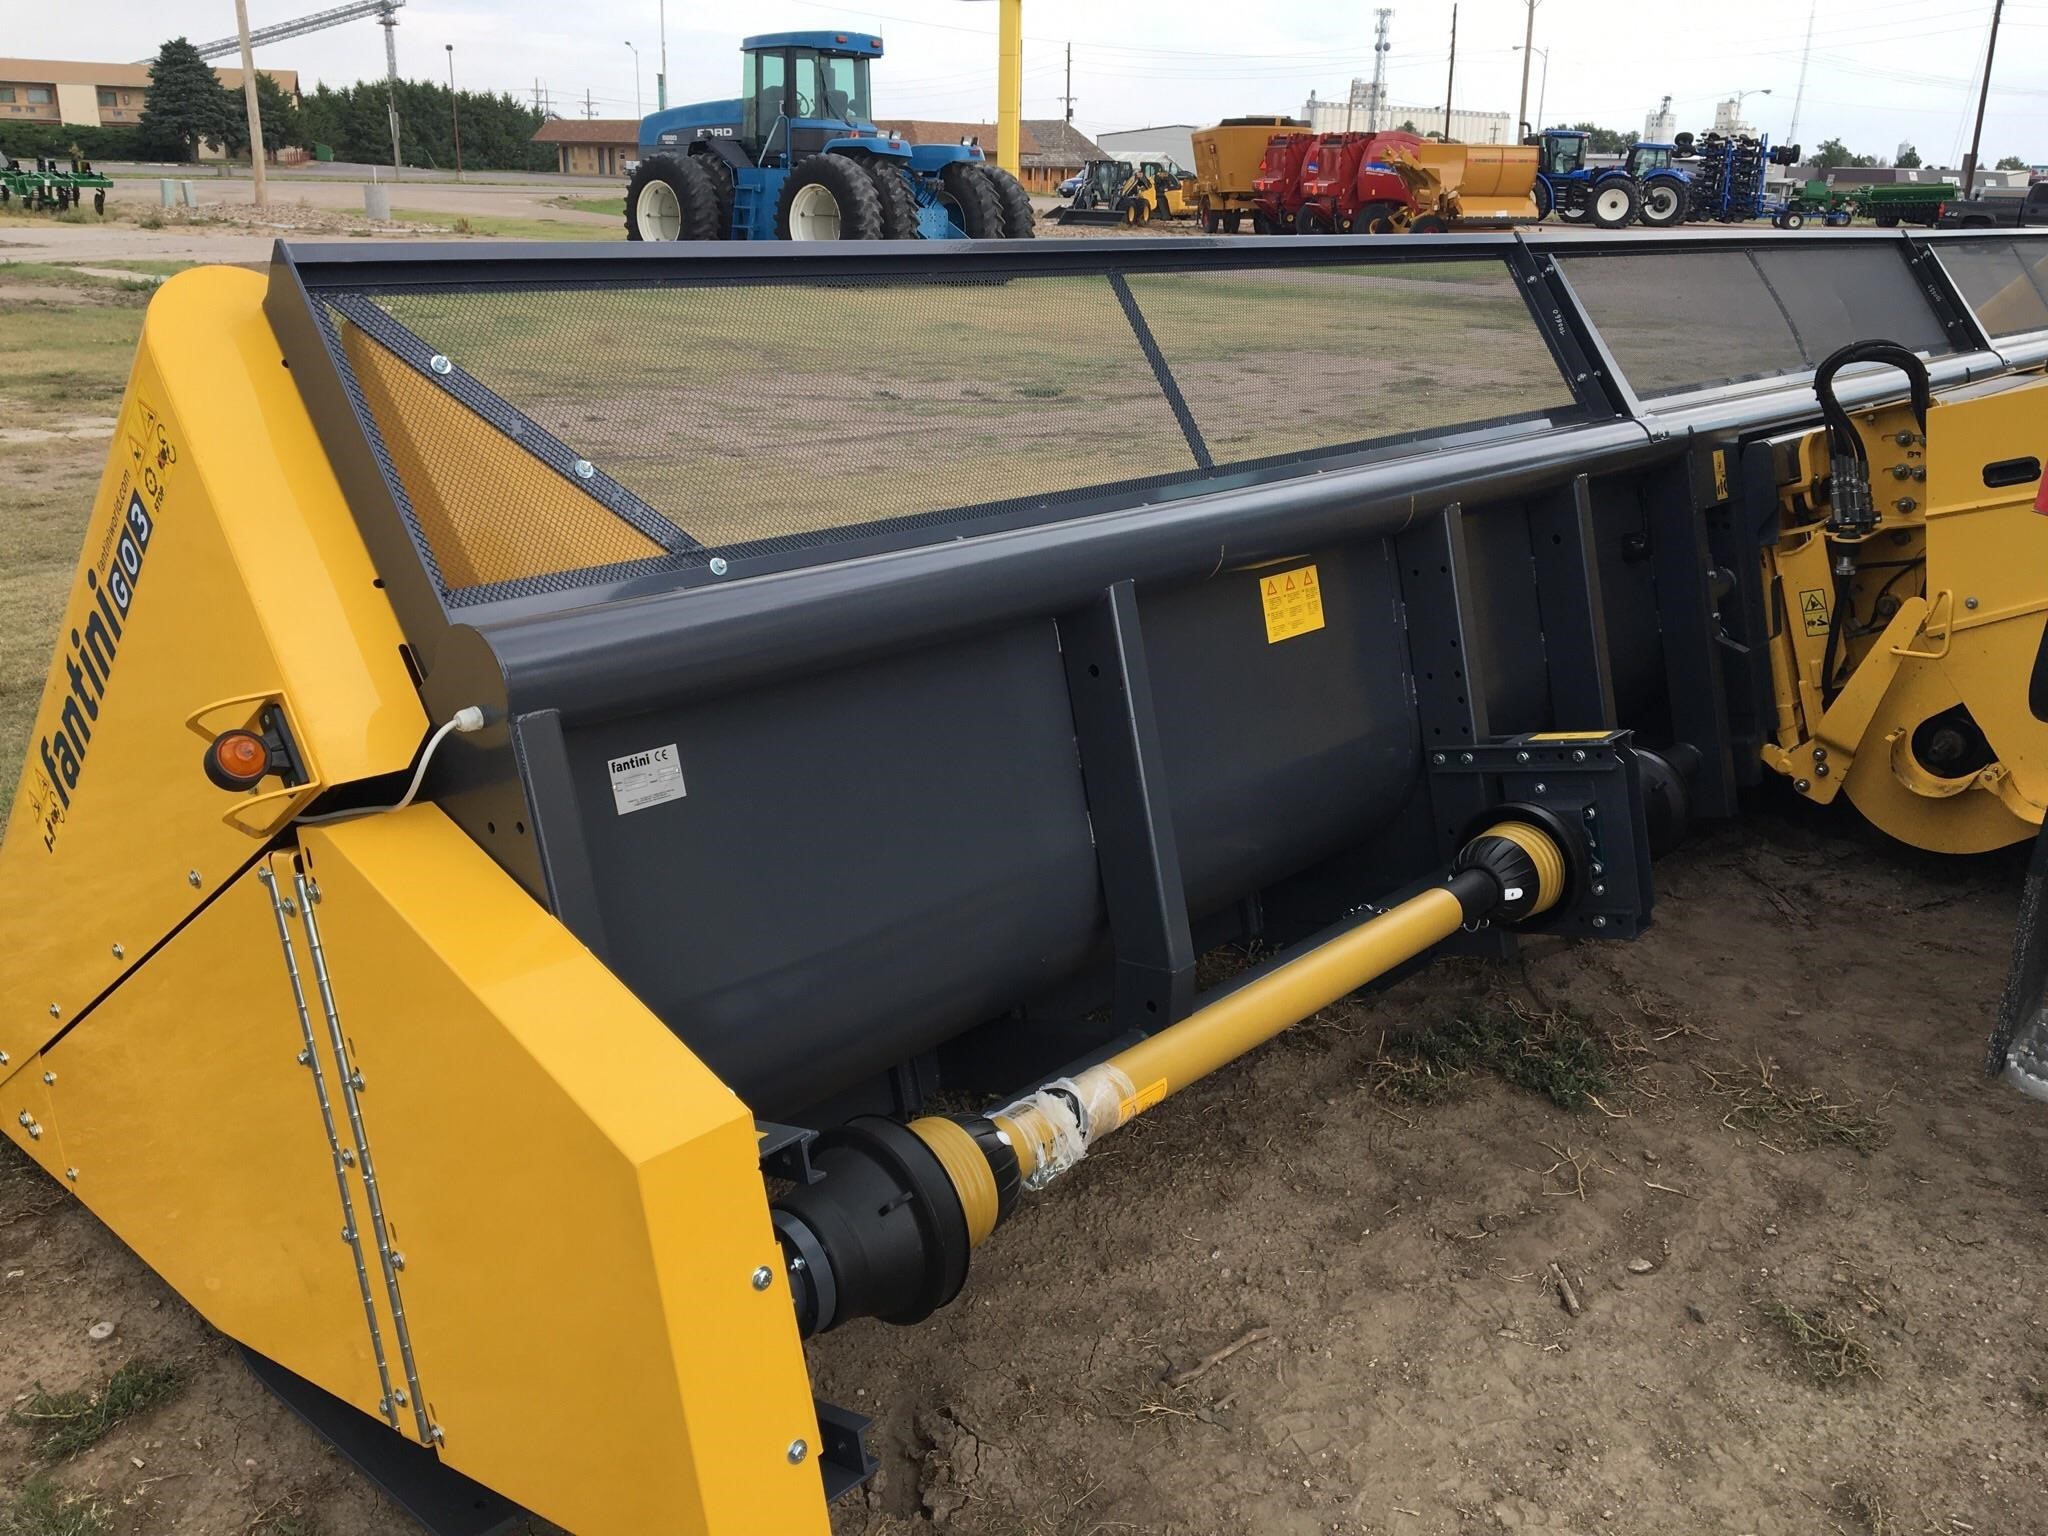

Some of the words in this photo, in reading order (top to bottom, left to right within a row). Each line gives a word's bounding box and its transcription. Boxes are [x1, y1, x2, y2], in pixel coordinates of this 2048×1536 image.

[96, 469, 131, 575] fantiniworld.com
[153, 485, 165, 513] STOP
[41, 568, 122, 812] fantini
[611, 753, 650, 773] fantini
[654, 749, 668, 762] CE
